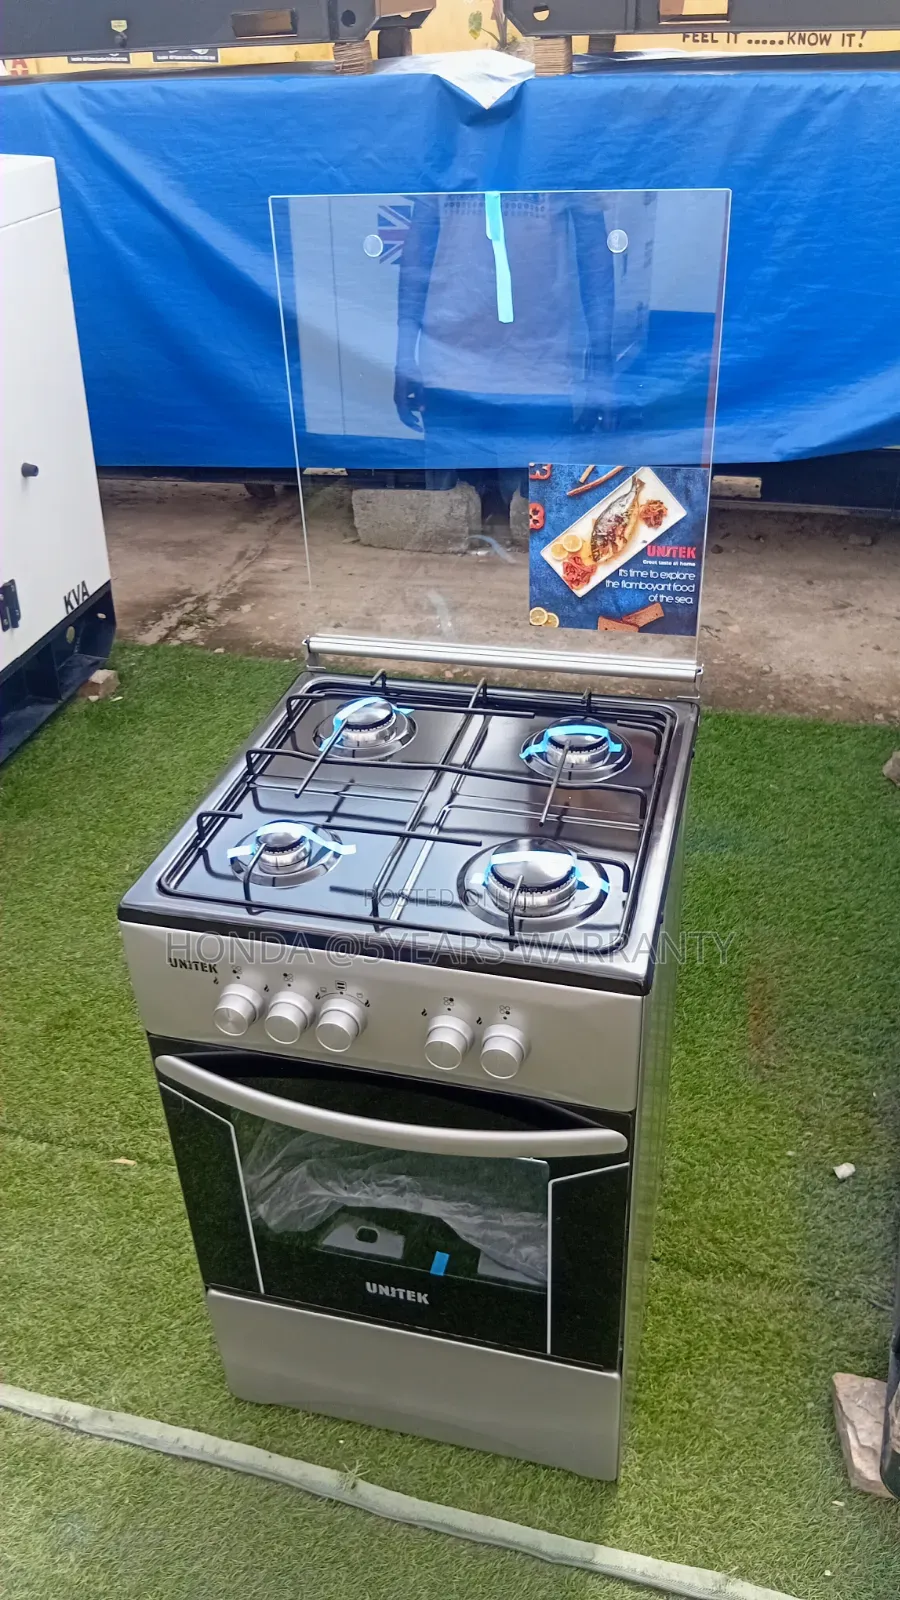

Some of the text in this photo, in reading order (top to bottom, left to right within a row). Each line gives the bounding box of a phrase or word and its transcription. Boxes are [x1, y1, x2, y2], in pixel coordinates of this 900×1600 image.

[682, 32, 719, 43] FEEL
[647, 545, 696, 559] UNITEK
[629, 569, 649, 578] time
[649, 570, 659, 579] to
[660, 571, 696, 580] explore
[605, 580, 696, 592] the flamboyant food
[63, 580, 90, 615] KVA
[648, 594, 660, 603] of
[660, 594, 674, 603] the
[169, 957, 218, 974] UNITEK
[365, 1281, 430, 1305] UNITEK
